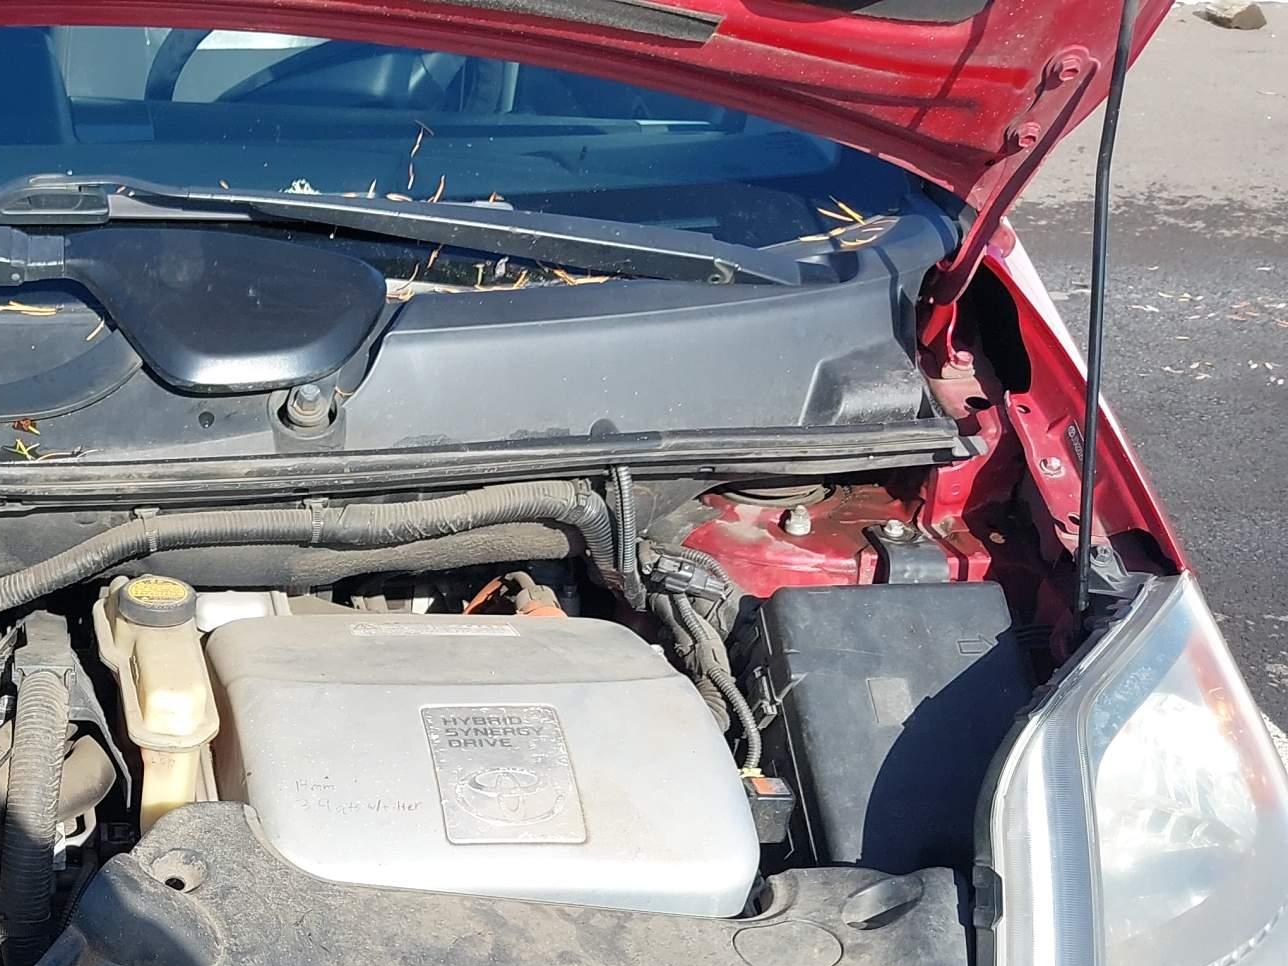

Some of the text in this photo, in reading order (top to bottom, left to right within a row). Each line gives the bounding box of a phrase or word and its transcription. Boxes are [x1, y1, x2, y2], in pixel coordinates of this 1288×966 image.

[442, 716, 523, 726] HYBRID
[446, 727, 544, 737] SYNERGY
[448, 738, 513, 748] DRIVE
